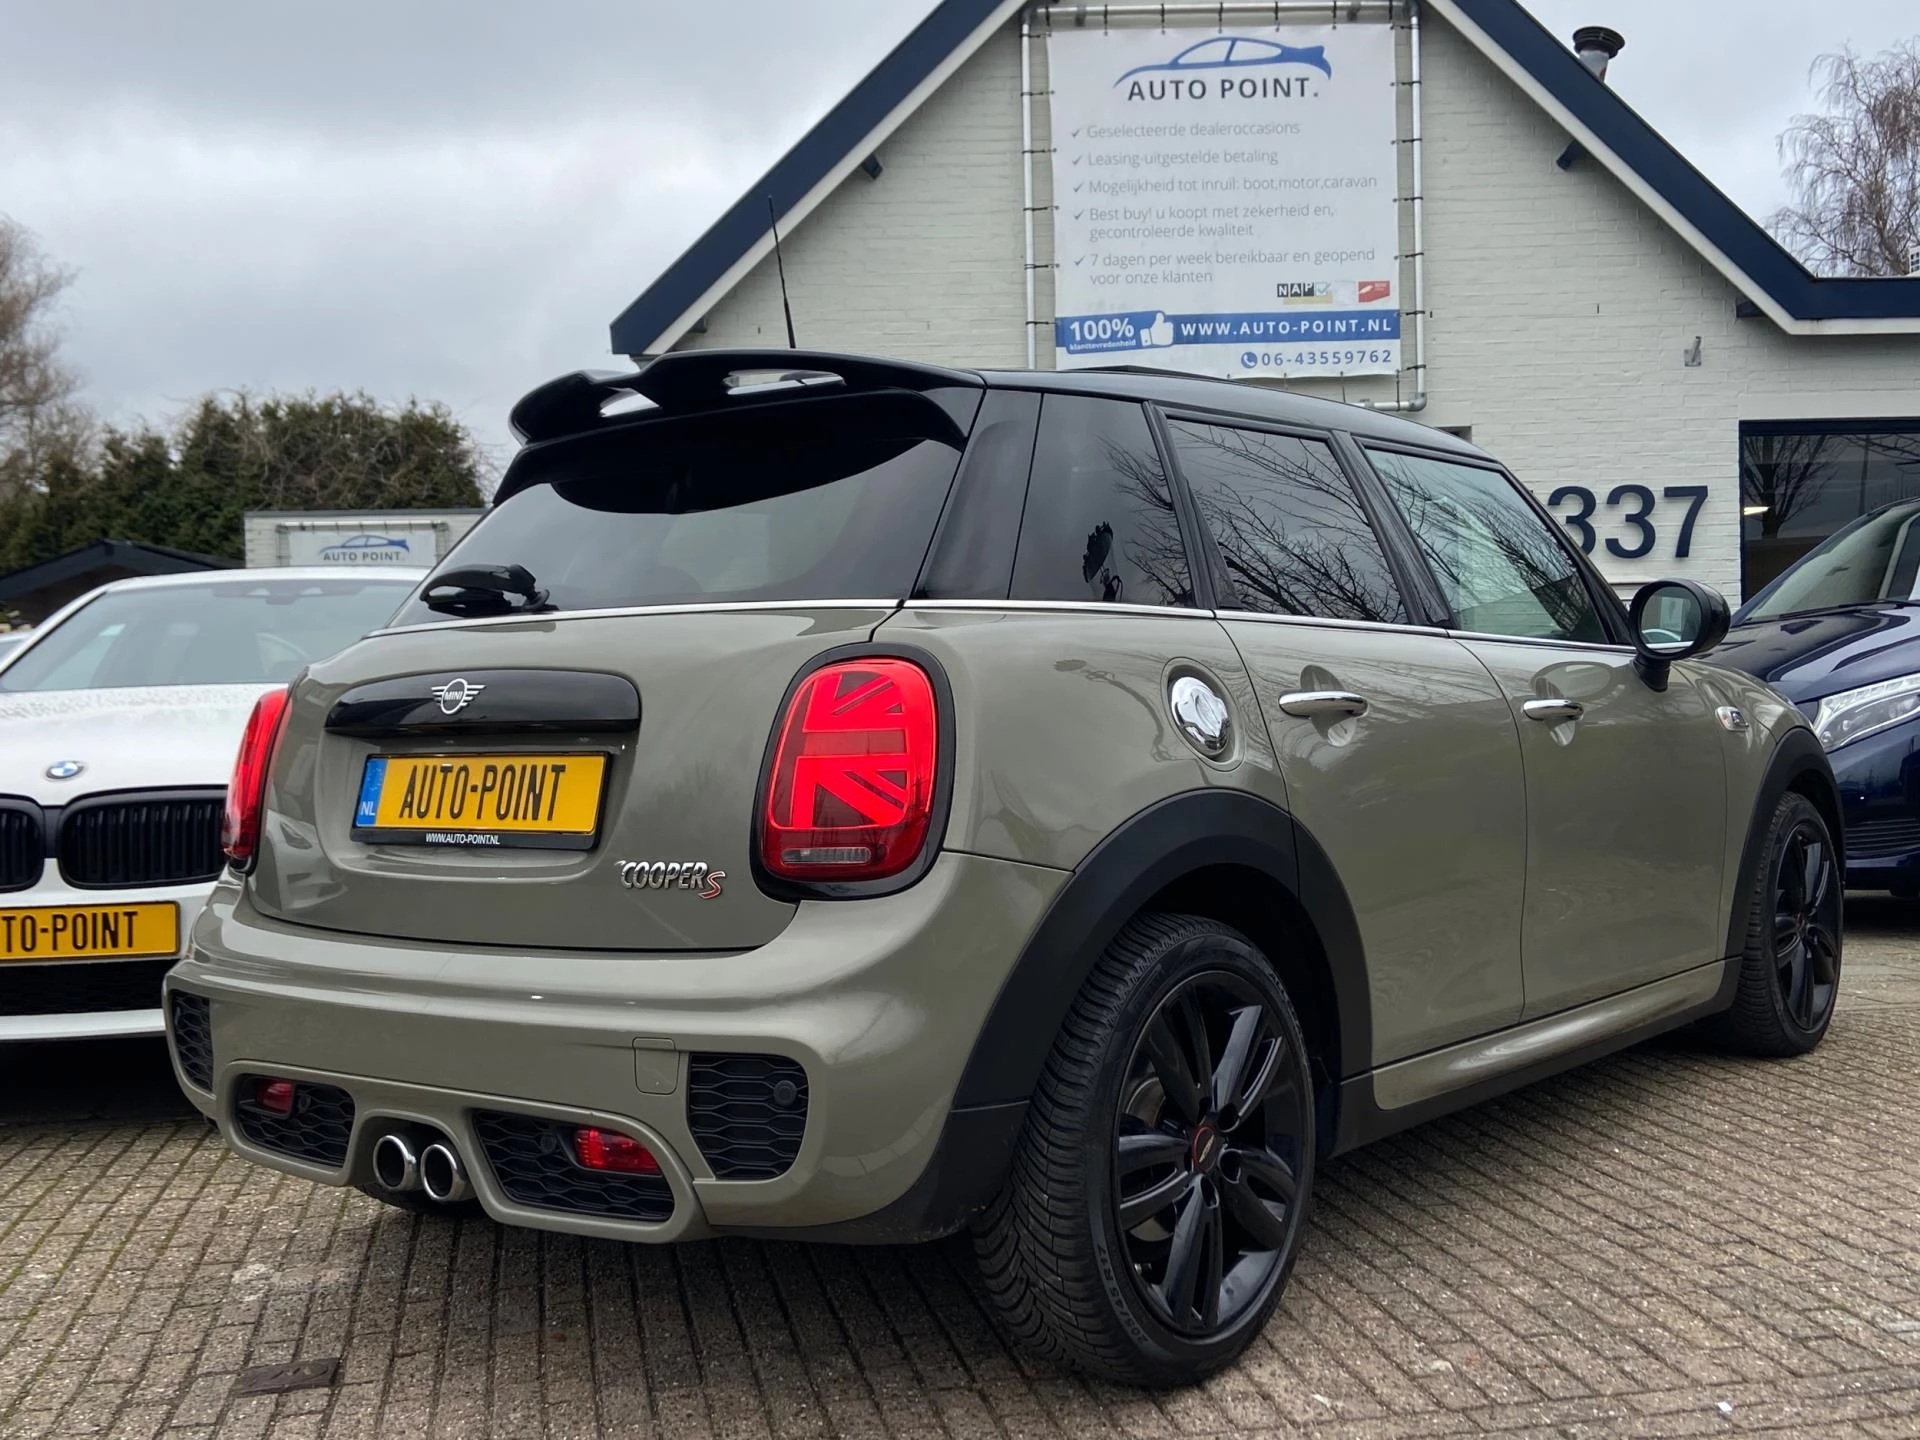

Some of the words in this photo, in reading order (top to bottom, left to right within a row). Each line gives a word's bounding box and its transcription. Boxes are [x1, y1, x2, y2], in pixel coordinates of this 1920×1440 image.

[1128, 79, 1207, 101] AUTO
[1220, 77, 1319, 100] POINT.
[1086, 124, 1187, 139] Geselecteerde
[1190, 122, 1301, 137] dealeroccasions
[1088, 151, 1220, 169] Leasing-uitgestelde
[1224, 149, 1279, 166] betaling
[1089, 177, 1175, 196] Mogelijkheid
[1179, 178, 1198, 192] tot
[1243, 175, 1378, 191] boot,motor,caravan
[1089, 207, 1119, 221] Best
[1156, 209, 1165, 219] u
[1169, 205, 1208, 222] koopt
[1212, 205, 1239, 219] met
[1243, 203, 1310, 218] zekerheid
[1090, 223, 1195, 242] gecontroleerde
[1198, 222, 1254, 237] kwaliteit
[1090, 253, 1099, 267] 7
[1102, 253, 1146, 270] dagen
[1149, 253, 1171, 269] per
[1176, 251, 1213, 266] week
[1215, 249, 1288, 265] bereikbaar
[1293, 251, 1310, 262] en
[1314, 248, 1376, 265] geopend
[1090, 272, 1121, 285] voor
[1125, 271, 1159, 285] onze
[1162, 270, 1213, 284] klanten
[1277, 282, 1315, 298] NAP
[1070, 318, 1135, 341] 100%
[1181, 319, 1392, 336] WWW.AUTO-POINT.NL
[1261, 350, 1392, 367] 06-43559762
[1547, 484, 1709, 559] 337
[323, 551, 358, 562] AUTO
[444, 691, 463, 700] MINI
[398, 764, 566, 821] AUTO-POINT
[360, 801, 376, 816] NL
[615, 860, 708, 889] COOPER
[1, 910, 138, 953] TO-POINT
